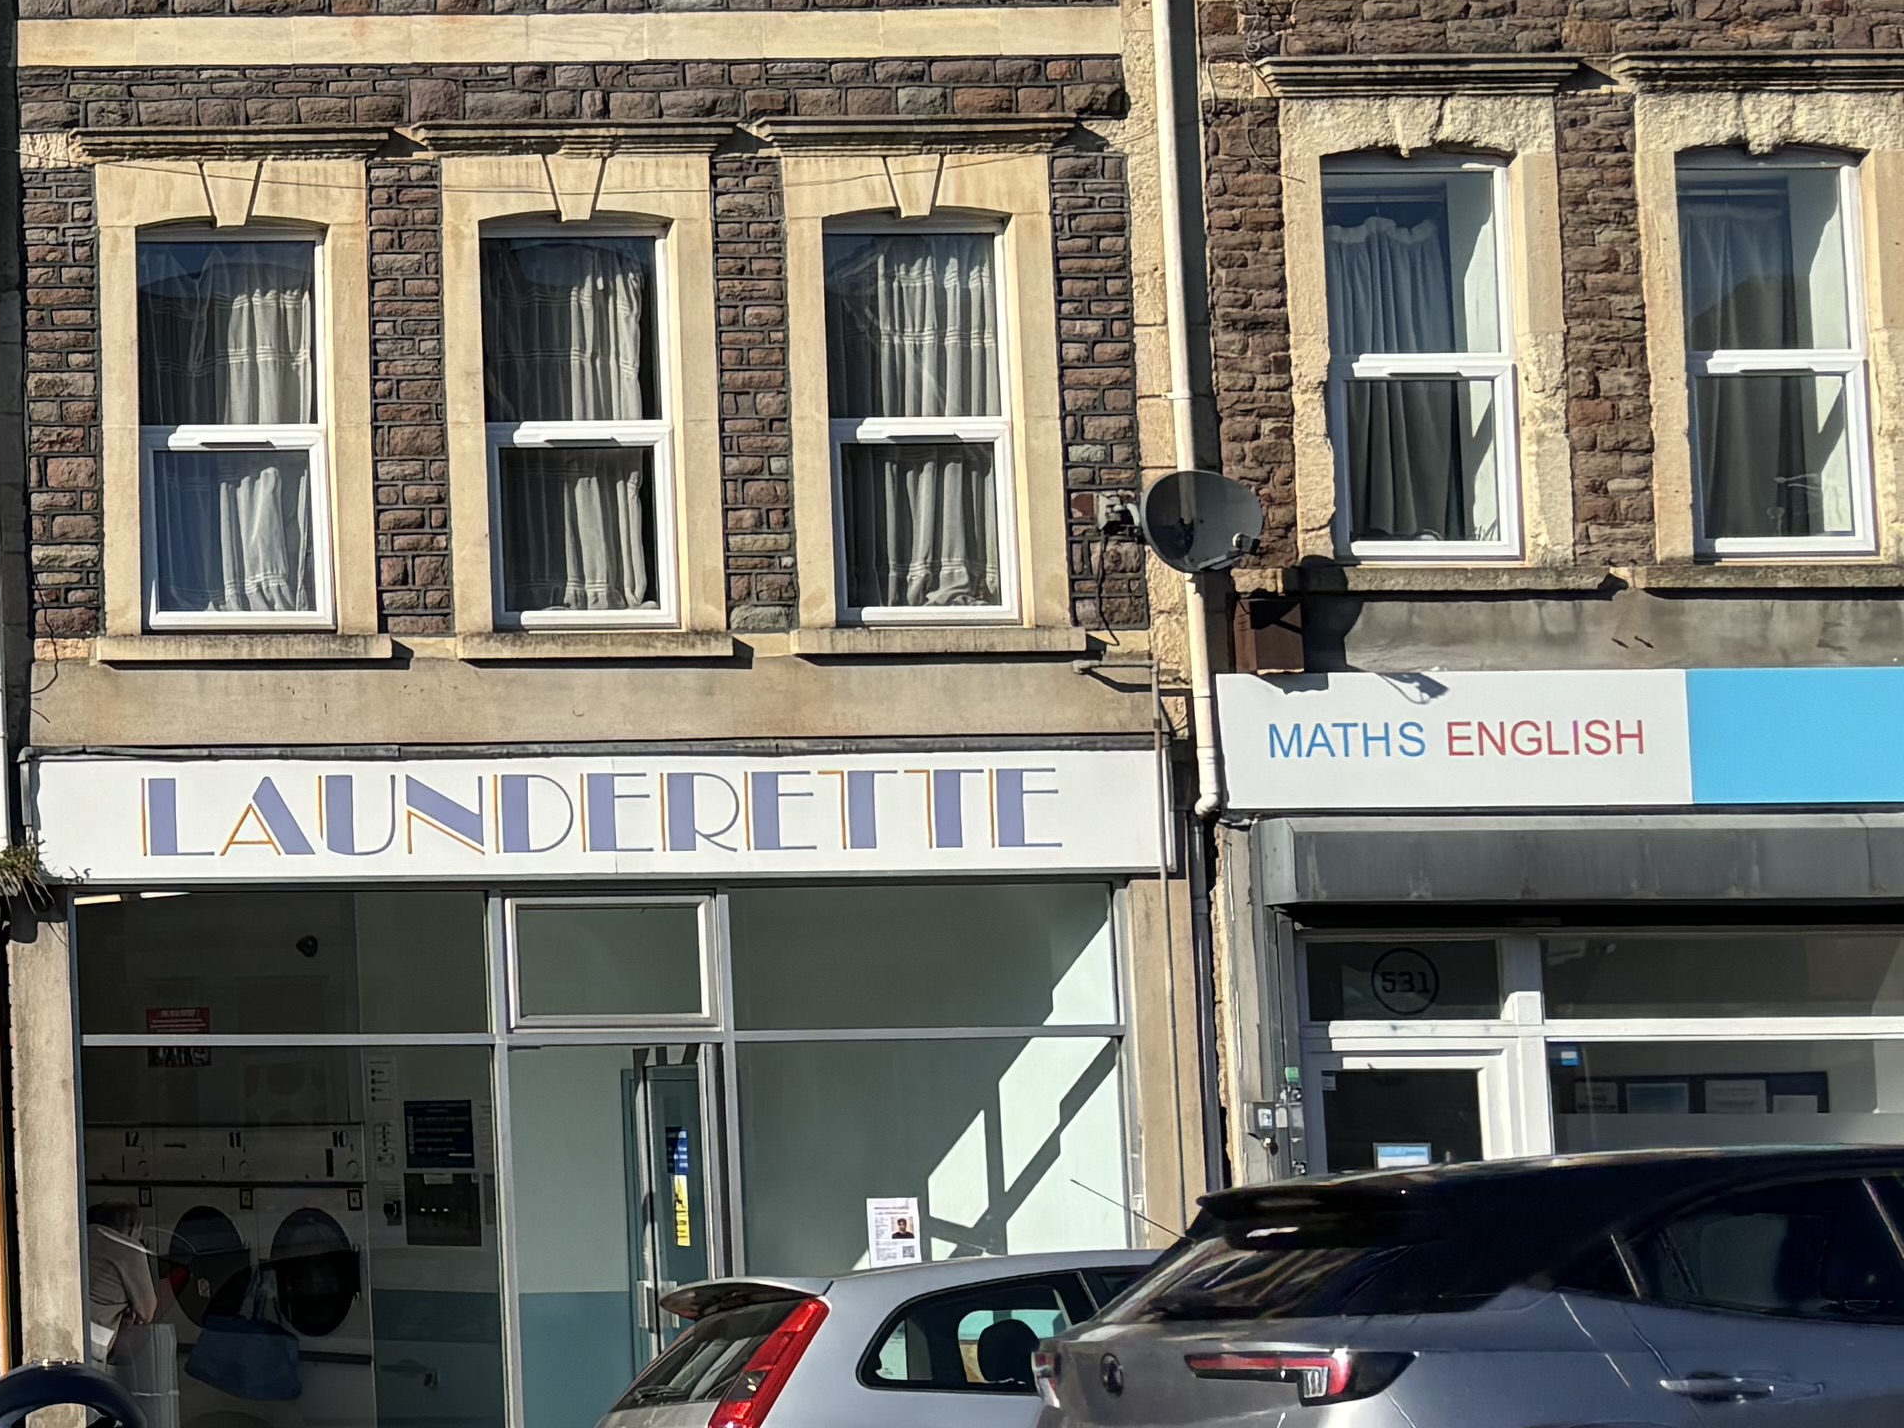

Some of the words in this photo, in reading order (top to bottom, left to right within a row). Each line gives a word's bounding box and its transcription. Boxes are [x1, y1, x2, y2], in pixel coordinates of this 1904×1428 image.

[1268, 721, 1425, 759] MATHS
[1447, 719, 1645, 756] ENGLISH
[141, 766, 1062, 857] LAUNDERETTE
[1381, 972, 1431, 993] 531
